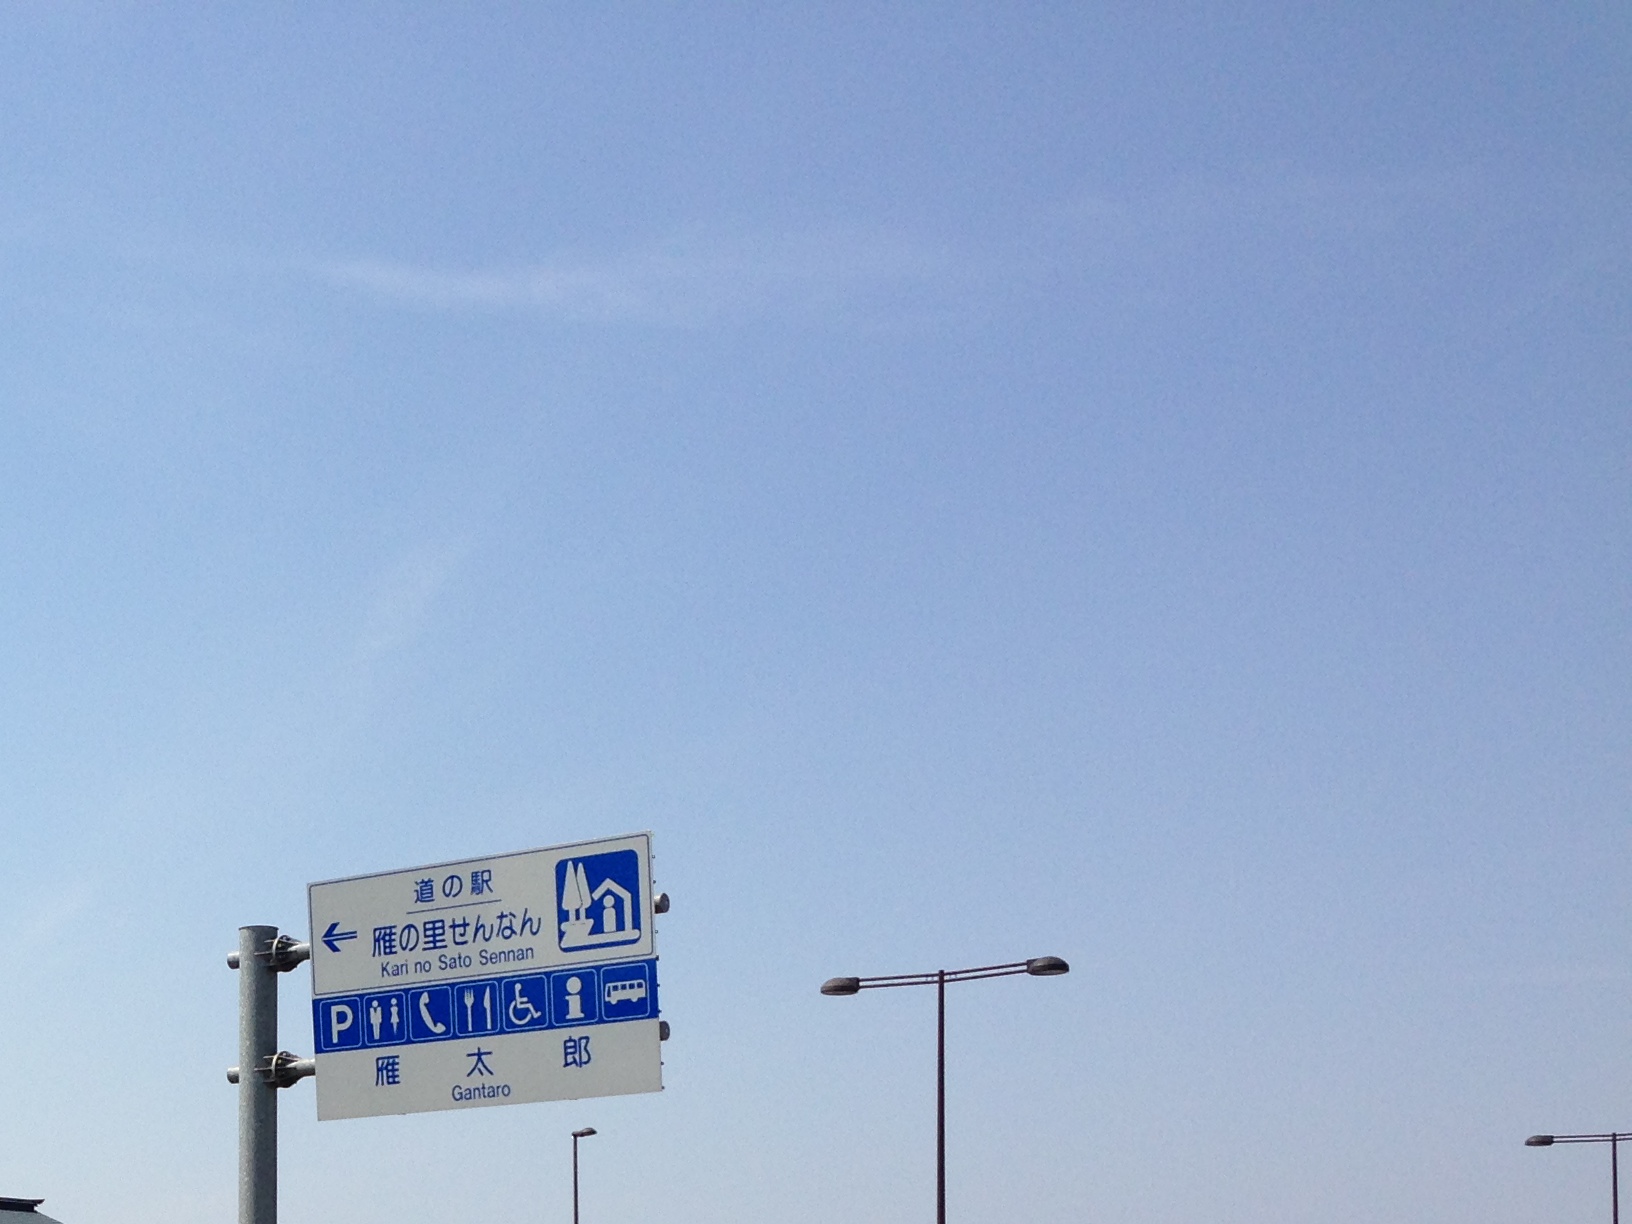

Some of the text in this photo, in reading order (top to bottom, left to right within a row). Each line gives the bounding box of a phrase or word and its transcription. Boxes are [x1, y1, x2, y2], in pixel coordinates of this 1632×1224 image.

[413, 868, 494, 904] 道の駅
[371, 907, 542, 958] 雁の里せんなん
[380, 946, 535, 979] Kari no Sato Sennan
[451, 1082, 512, 1102] Gantaro
